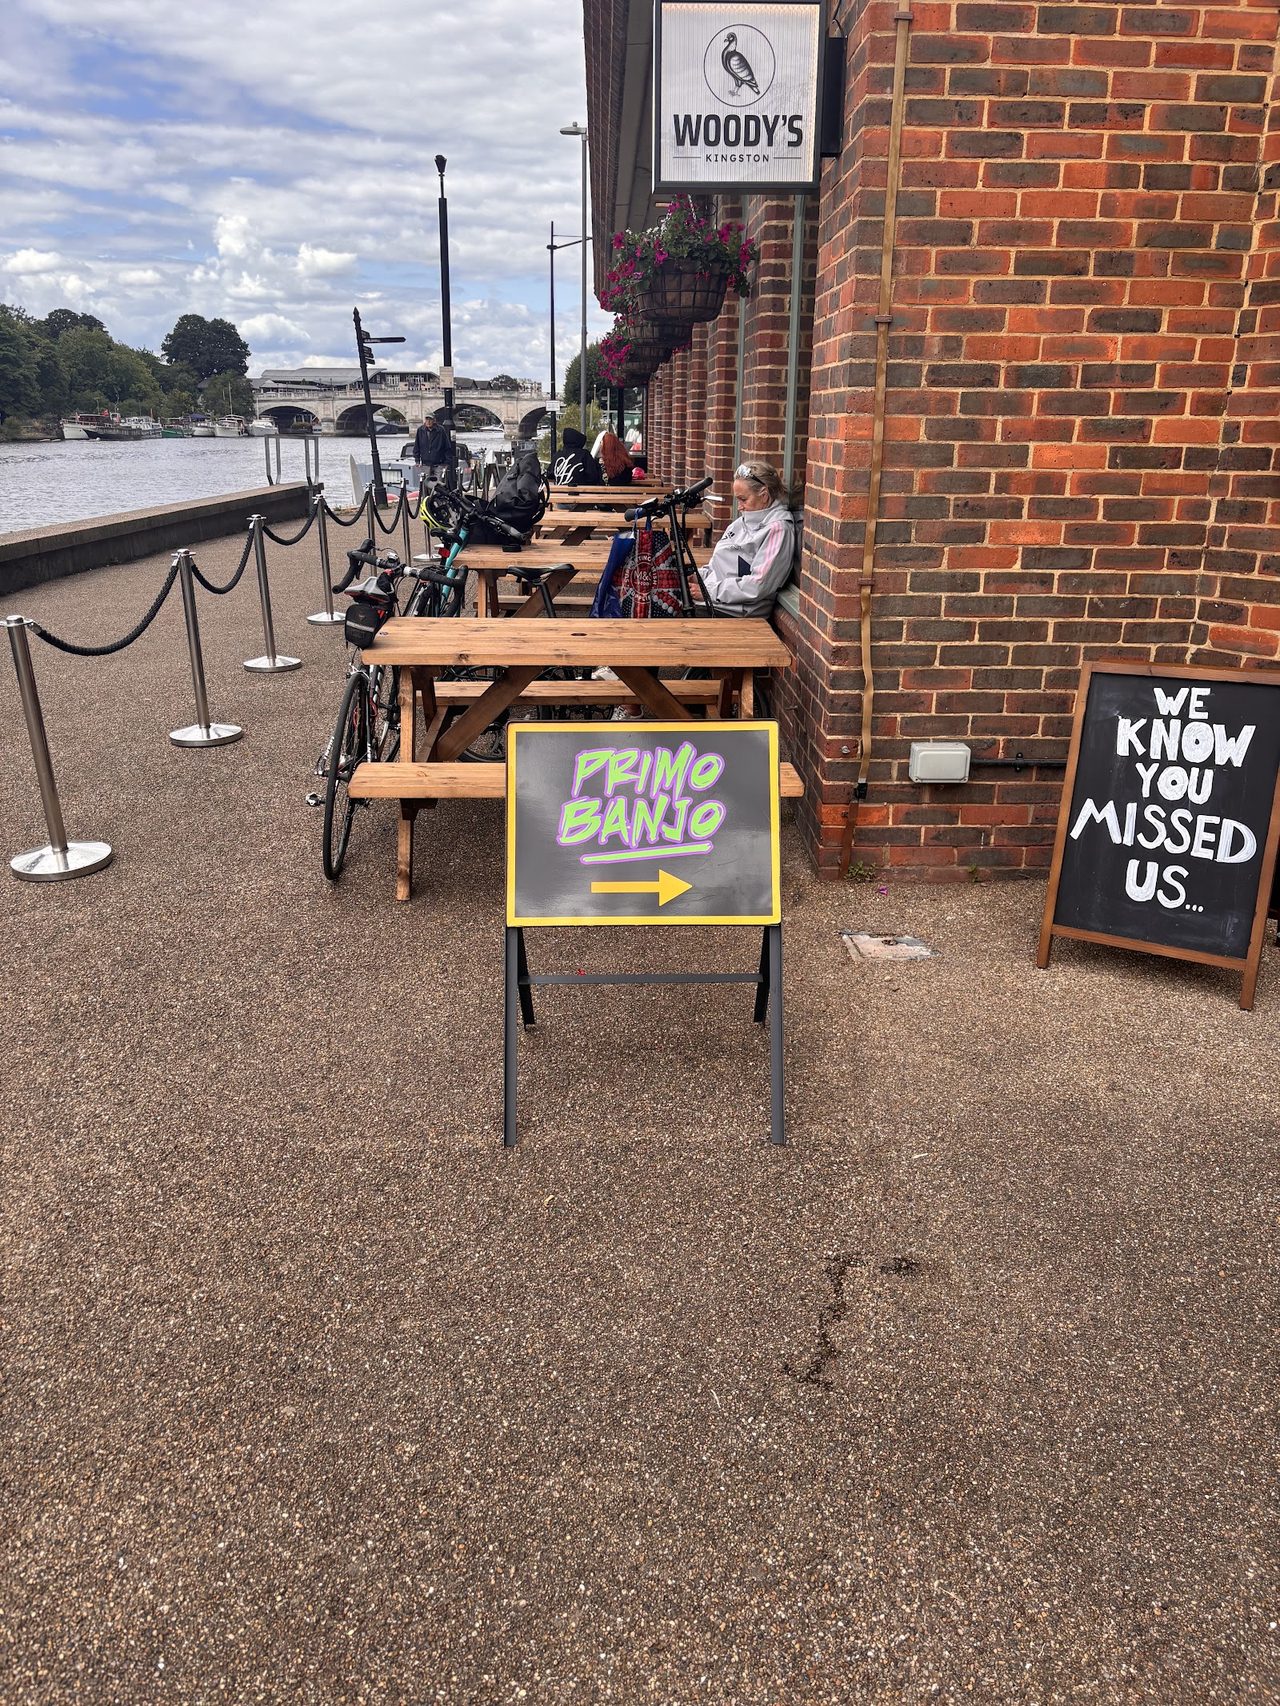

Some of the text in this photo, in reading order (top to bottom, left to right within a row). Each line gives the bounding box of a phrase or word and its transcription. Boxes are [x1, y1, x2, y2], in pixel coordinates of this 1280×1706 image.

[673, 114, 803, 147] WOODY'S
[705, 153, 770, 163] KINGSTON
[1153, 687, 1212, 720] WE
[1116, 716, 1256, 768] KNOW
[571, 740, 726, 800] PRIMO
[1135, 762, 1214, 805] YOU
[556, 792, 727, 848] BANJO
[1069, 798, 1258, 863] MISSED
[1125, 858, 1204, 913] US...
